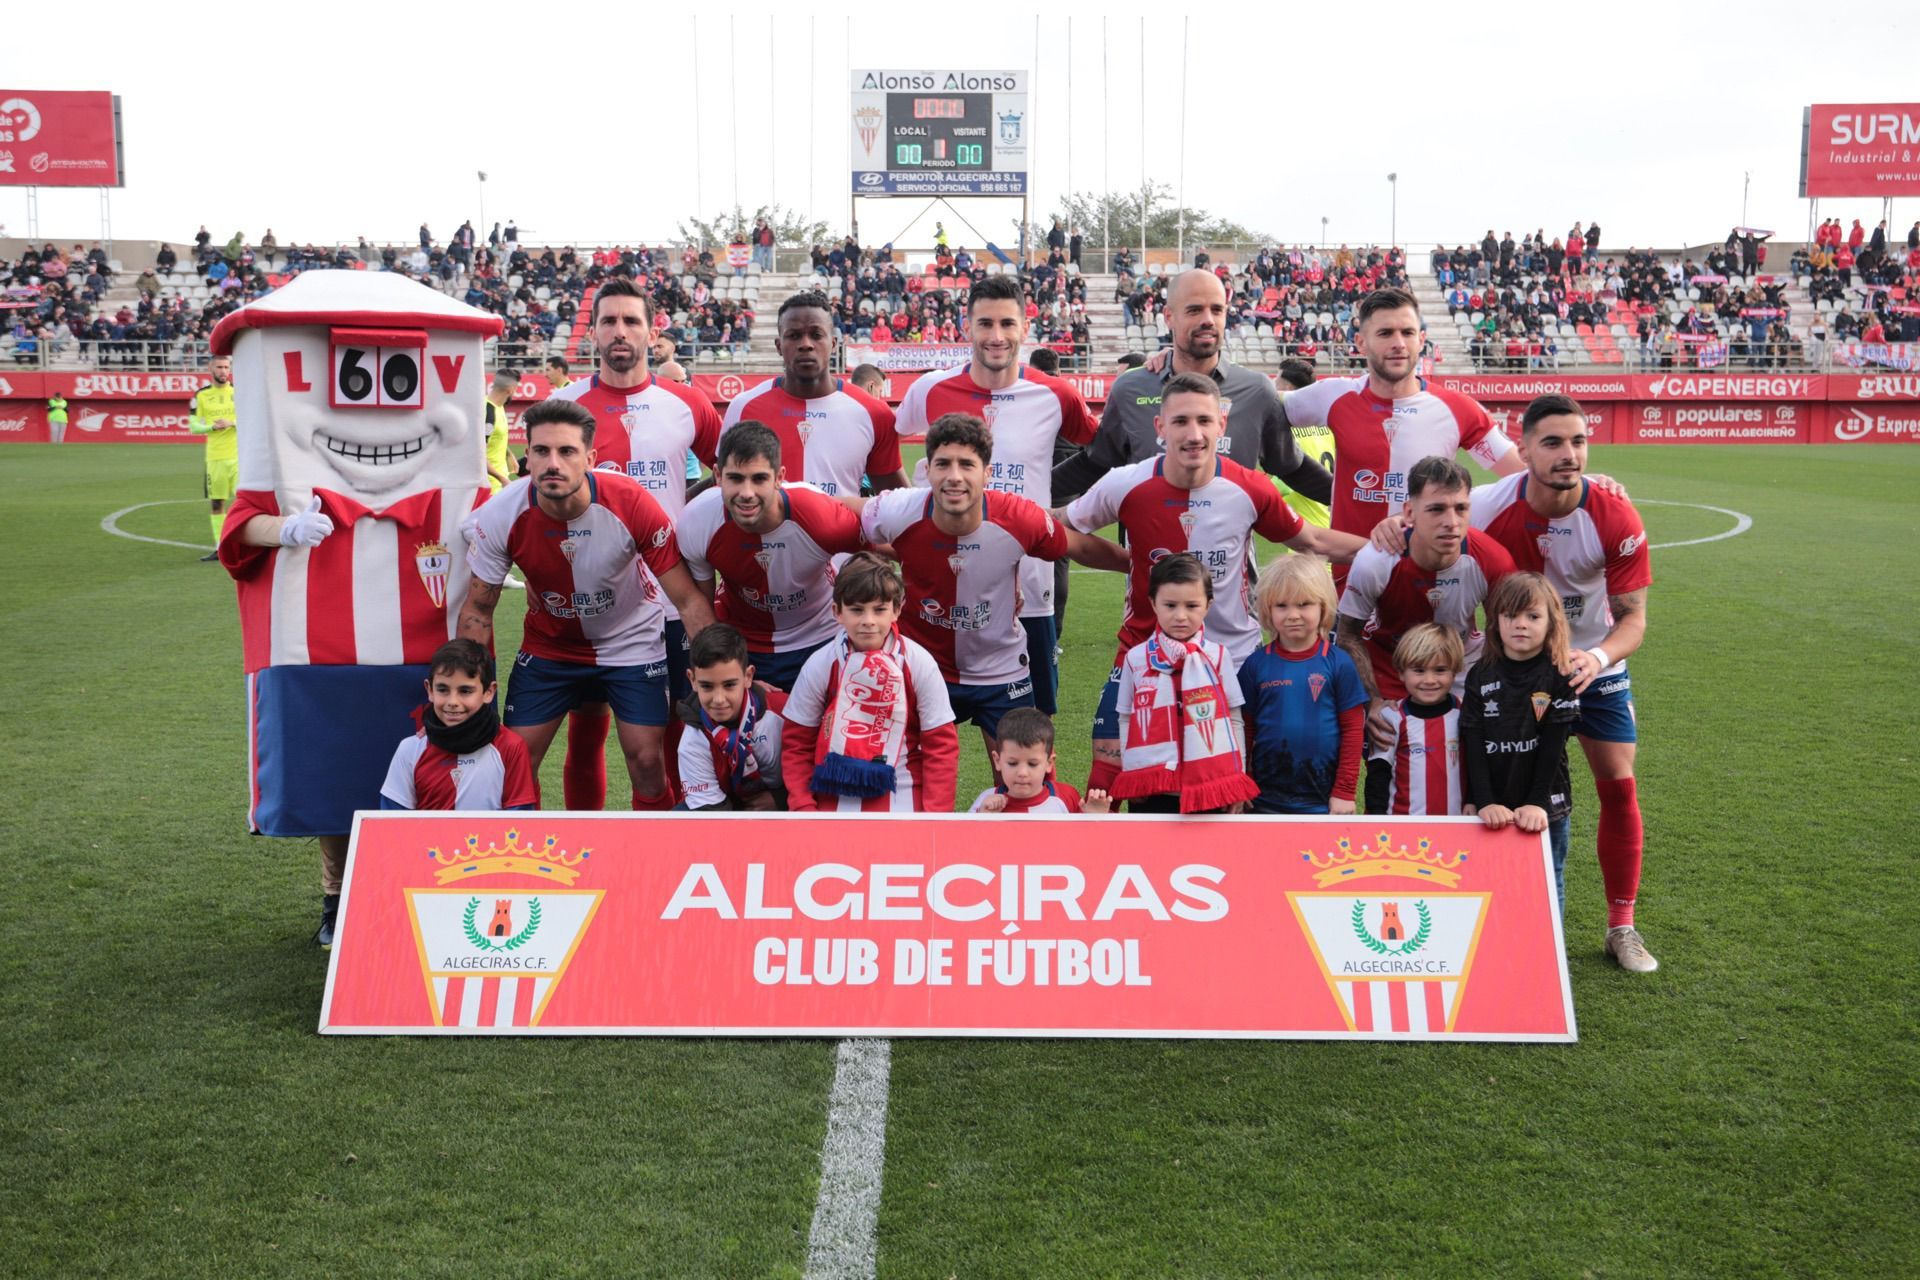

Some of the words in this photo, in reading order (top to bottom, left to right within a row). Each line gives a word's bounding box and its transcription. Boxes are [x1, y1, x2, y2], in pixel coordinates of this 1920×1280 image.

[862, 72, 935, 90] Alonso
[943, 72, 1016, 90] Alonso
[894, 127, 927, 136] LOCAL
[953, 128, 987, 136] VISITANTE
[897, 144, 922, 165] 00
[957, 144, 982, 165] 00
[1830, 151, 1896, 163] Industrial
[1902, 150, 1911, 163] &
[889, 173, 944, 182] PERMOTOR
[946, 173, 1002, 182] ALGECIRAS
[1003, 173, 1021, 182] S.L.
[896, 184, 937, 192] SERVICIO
[938, 184, 972, 192] OFICIAL
[888, 347, 937, 358] ORGULLO
[877, 360, 931, 370] ALGECIRAS
[1570, 383, 1625, 393] PODOLOGÍA
[1667, 379, 1801, 396] CAPENERGY
[1676, 406, 1762, 425] populares
[1639, 428, 1663, 437] CON
[1665, 428, 1677, 437] EL
[1679, 428, 1726, 437] DEPORTE
[1728, 426, 1796, 437] ALGECIREÑO
[660, 863, 1229, 921] ALGECIRAS
[753, 937, 879, 985] CLUB
[893, 939, 952, 985] DE
[967, 921, 1152, 986] FÚTBOL
[443, 957, 520, 969] ALGECIRAS
[524, 957, 547, 969] C.F.
[1343, 961, 1422, 973] ALGECIRAS
[1425, 961, 1450, 973] C.F.
